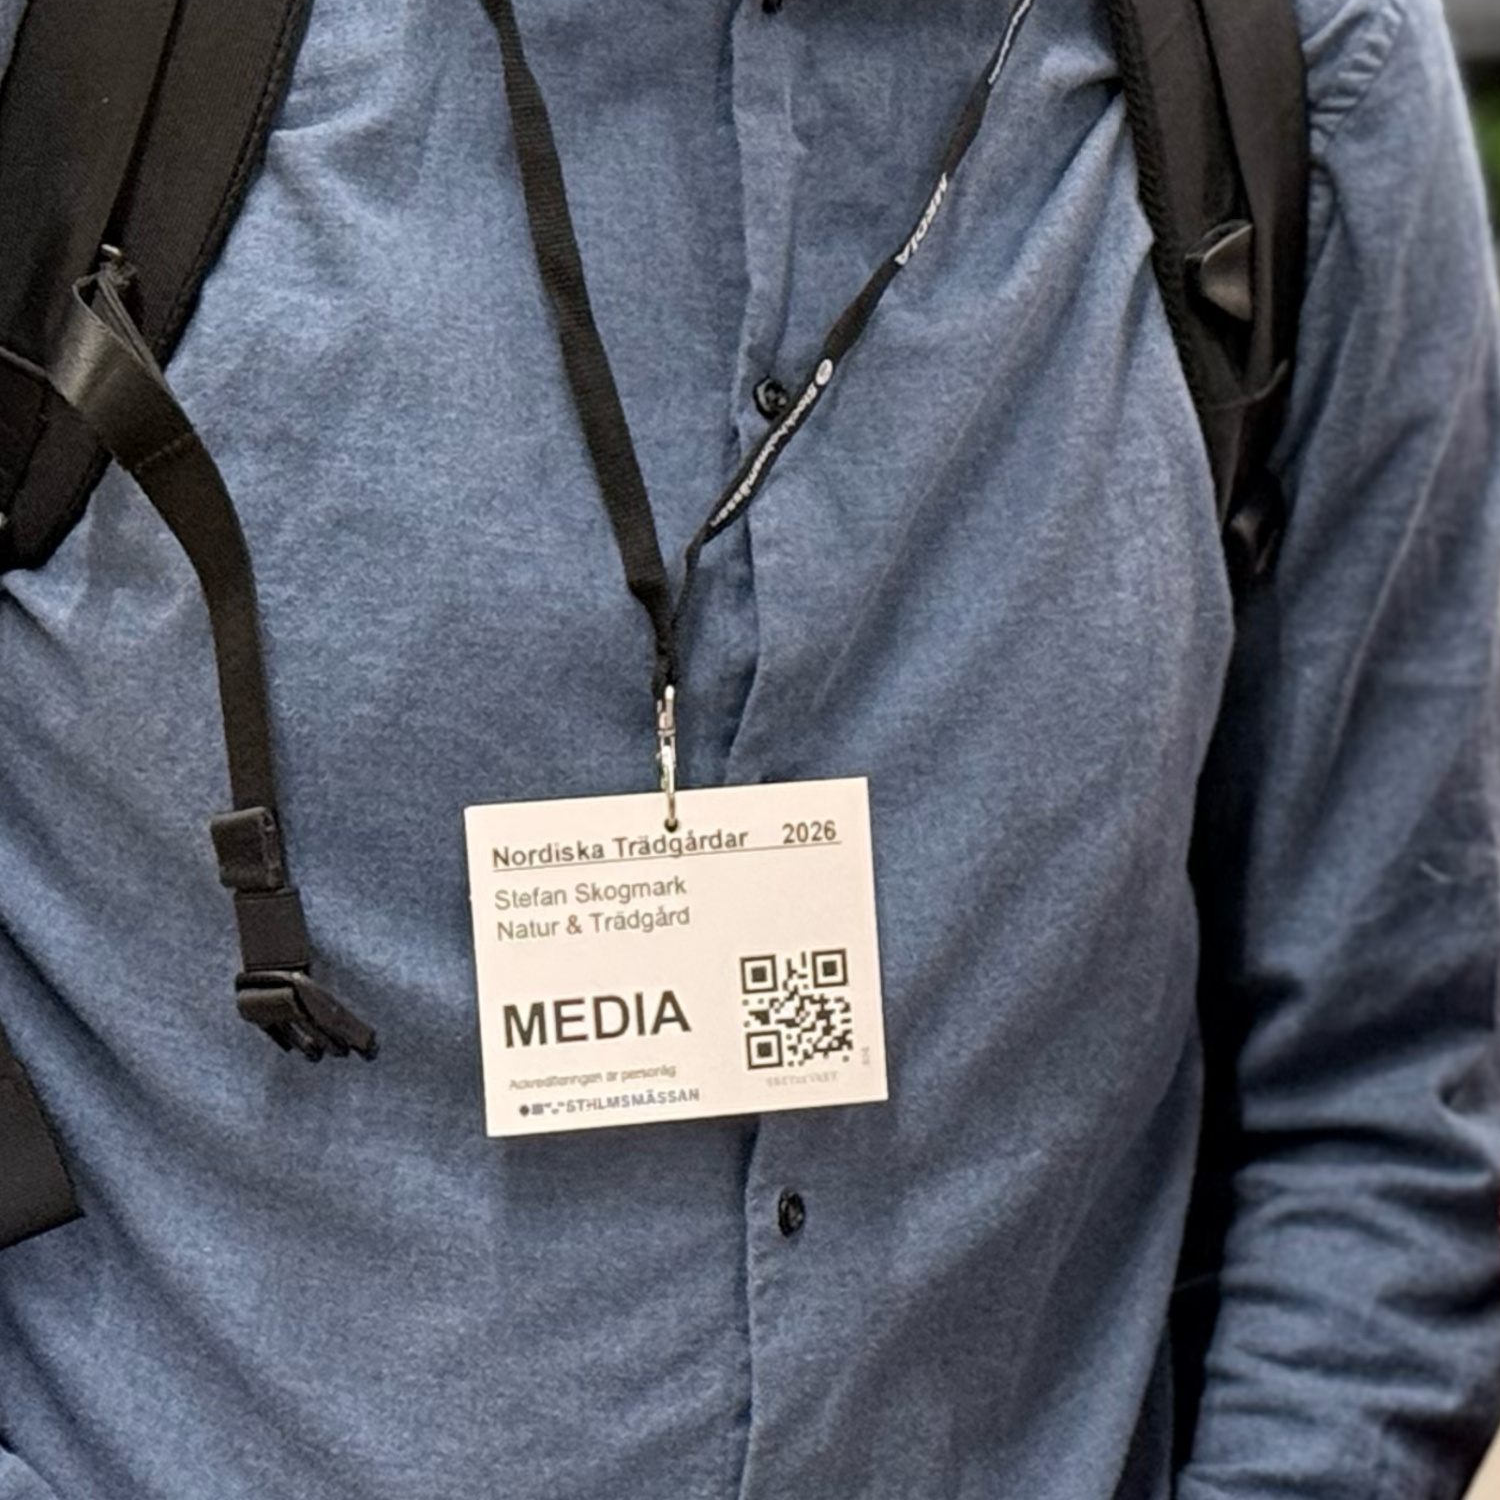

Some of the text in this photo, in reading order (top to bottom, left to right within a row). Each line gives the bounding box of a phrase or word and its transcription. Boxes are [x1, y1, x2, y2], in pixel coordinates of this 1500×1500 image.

[492, 819, 838, 869] Nordiska Trädgårdar 2026
[494, 875, 688, 911] Stefan Skogmark
[496, 904, 691, 942] Natur & Trädgård
[502, 989, 693, 1050] MEDIA
[565, 1087, 701, 1114] STHLMSMÄSSAN
